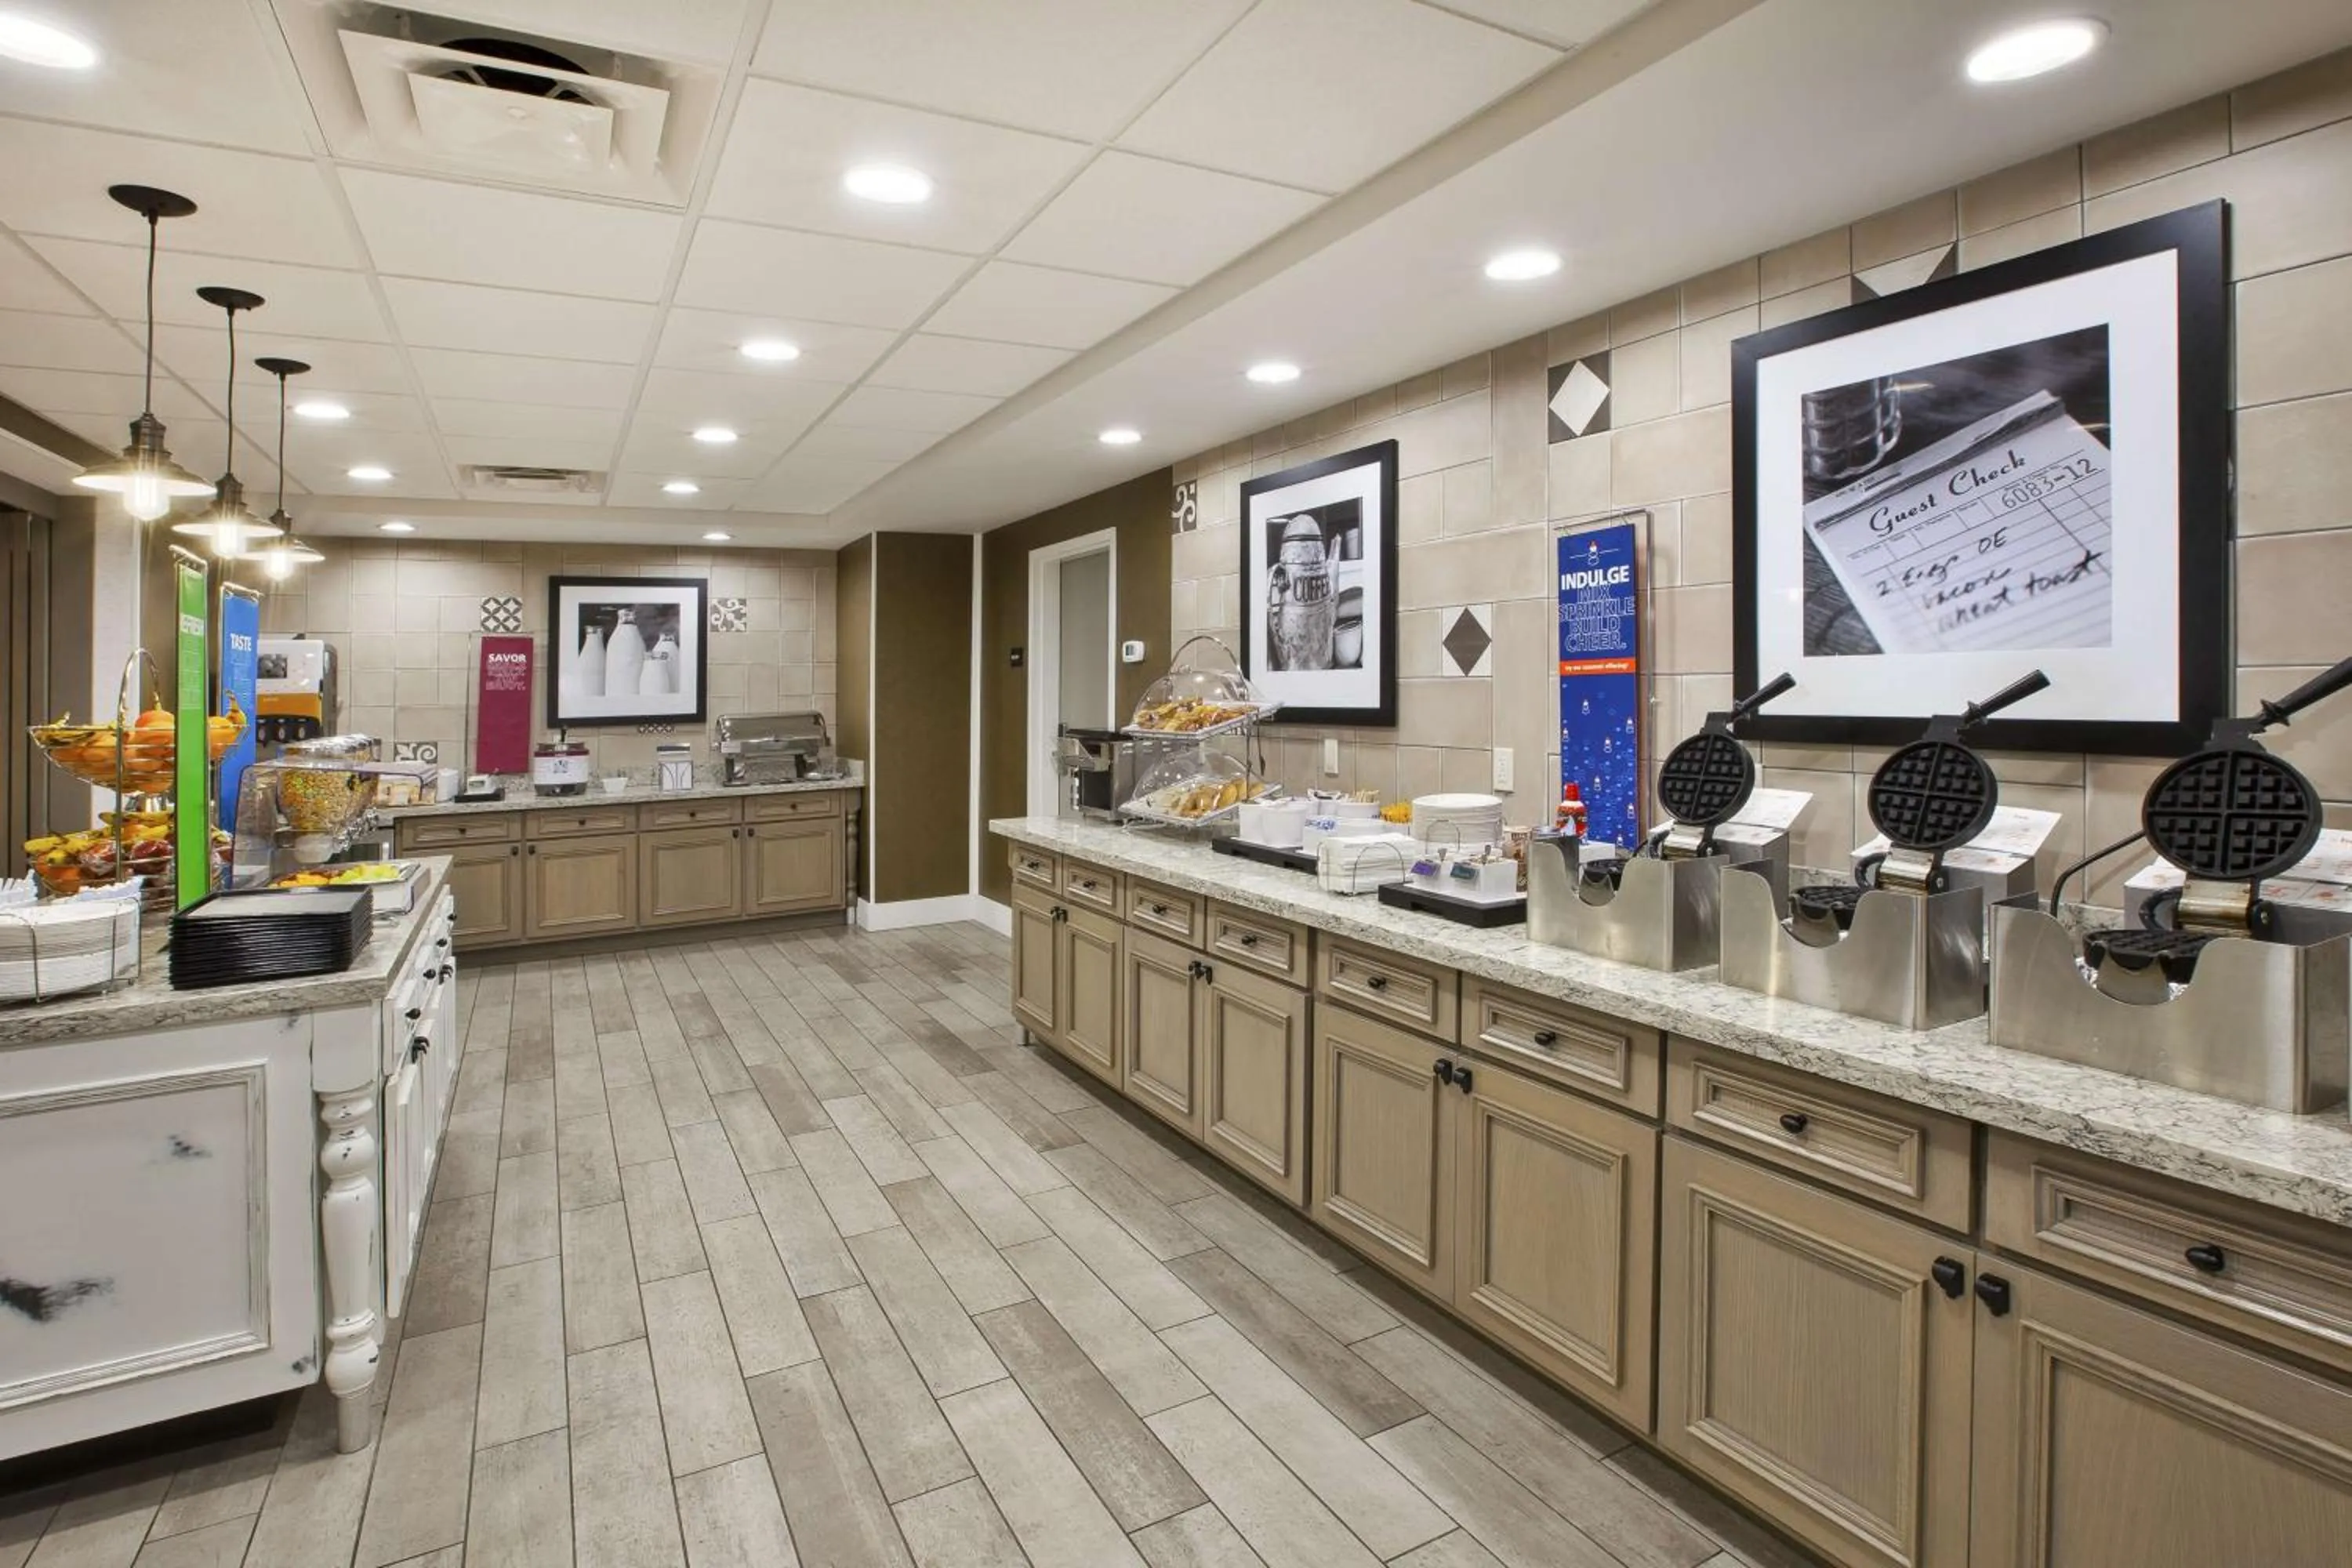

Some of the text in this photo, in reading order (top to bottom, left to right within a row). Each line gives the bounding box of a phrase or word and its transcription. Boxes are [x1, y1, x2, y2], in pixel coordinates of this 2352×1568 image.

[1870, 494, 1937, 536] Guest
[1949, 449, 2025, 495] Check
[2002, 459, 2099, 509] 6083-12
[1561, 564, 1630, 590] INDULGE
[1559, 597, 1635, 622] SPRINKLE
[1570, 615, 1621, 634] BUILD
[230, 633, 252, 652] TASTE
[488, 653, 527, 663] SAVOR
